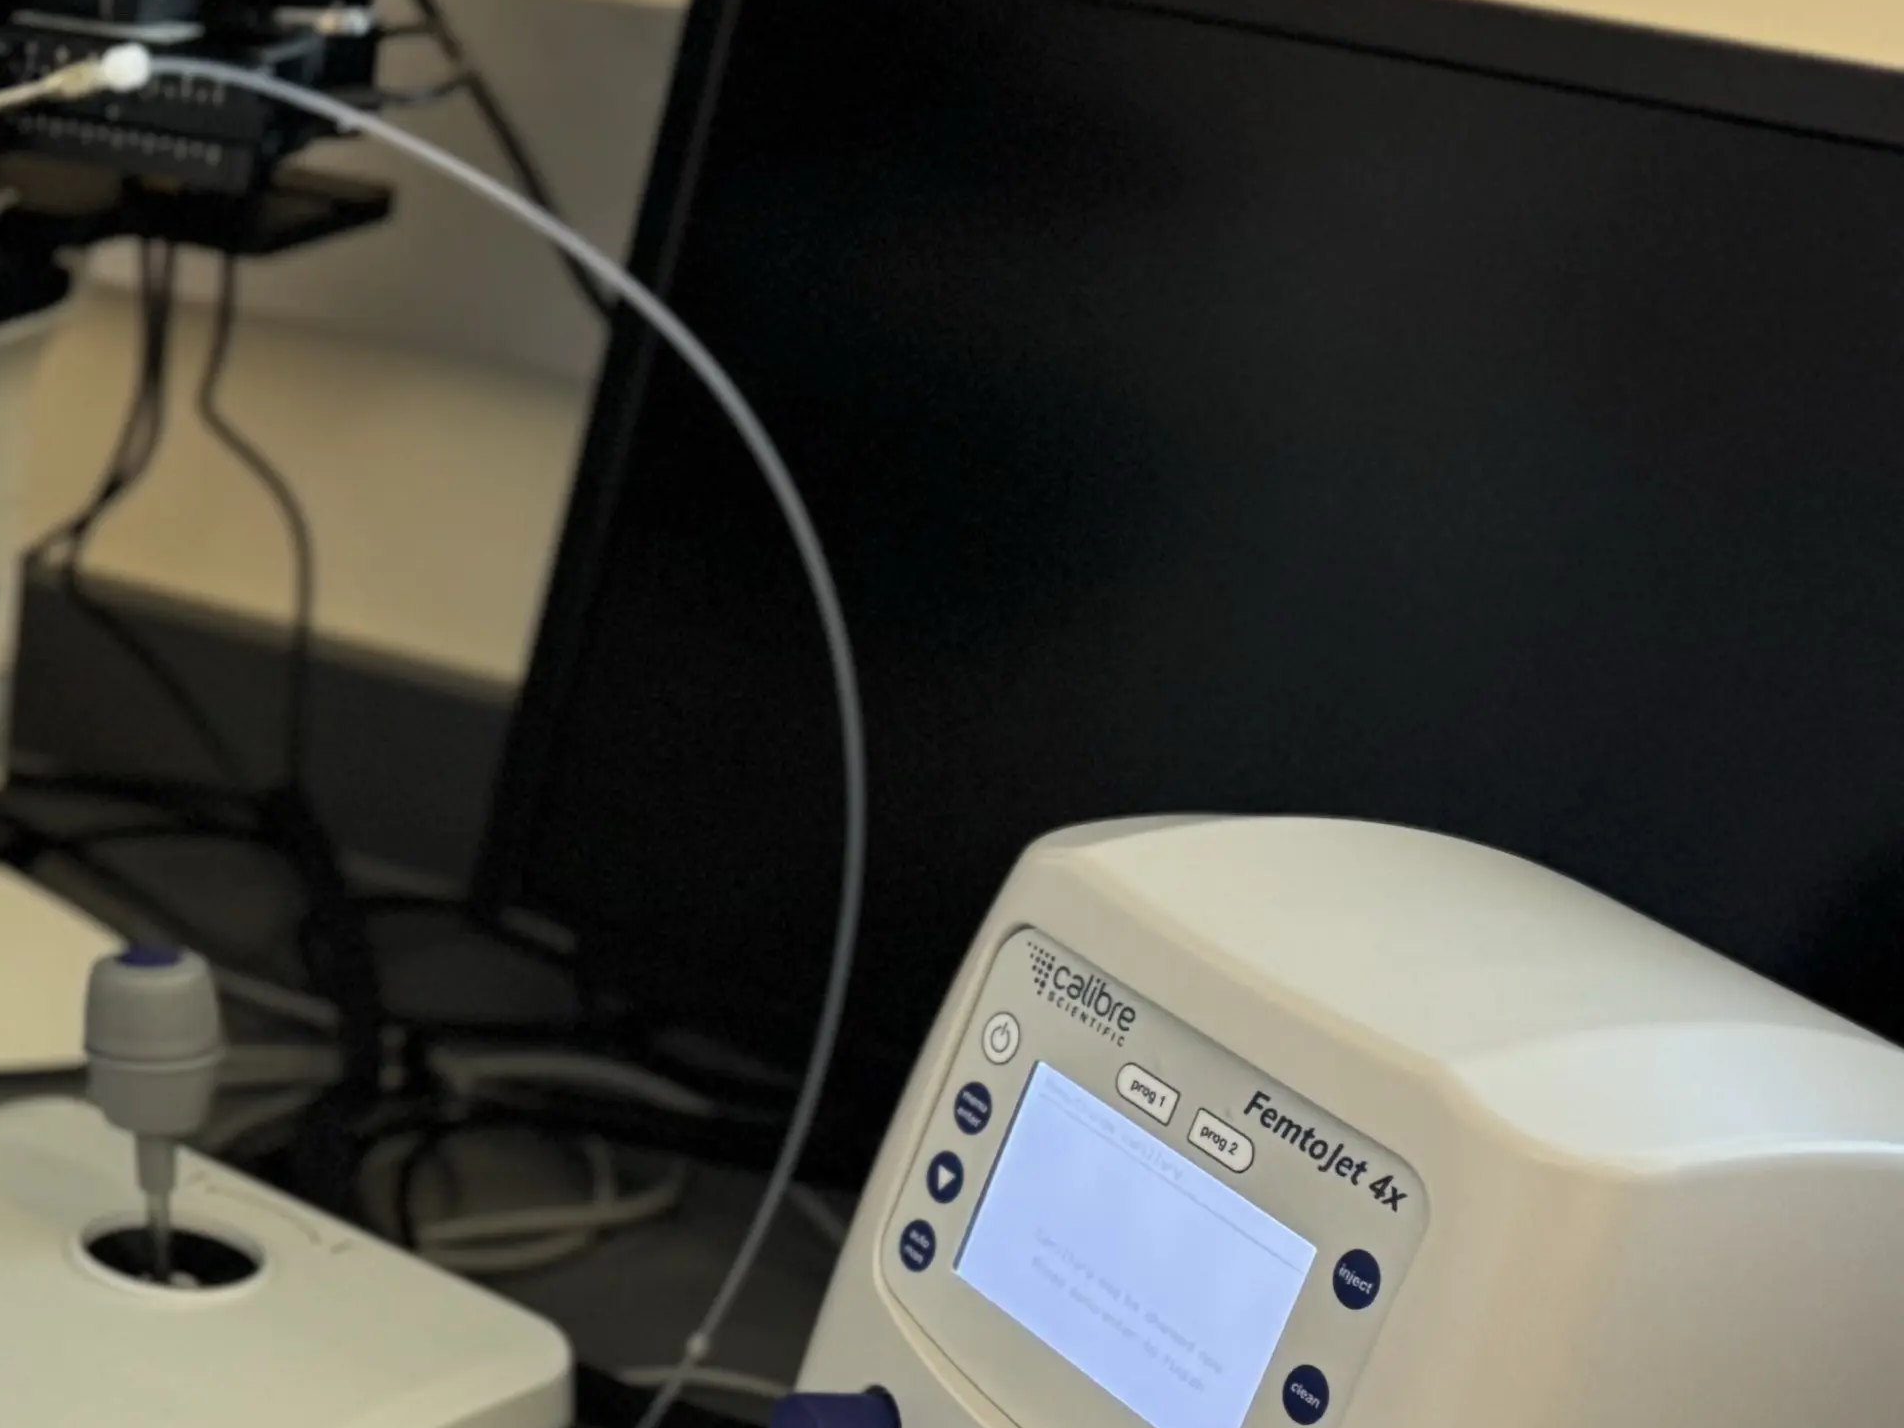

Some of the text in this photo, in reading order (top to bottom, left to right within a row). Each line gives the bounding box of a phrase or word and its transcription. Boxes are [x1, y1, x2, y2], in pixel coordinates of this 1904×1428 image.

[1053, 966, 1136, 1032] calibre
[1048, 991, 1125, 1047] SCIENTIFIC
[1130, 1078, 1167, 1108] prog 1
[1199, 1124, 1240, 1156] prog 2
[1244, 1090, 1408, 1213] FemtoJet 4x
[1339, 1263, 1372, 1294] inject
[1290, 1381, 1320, 1409] clean
